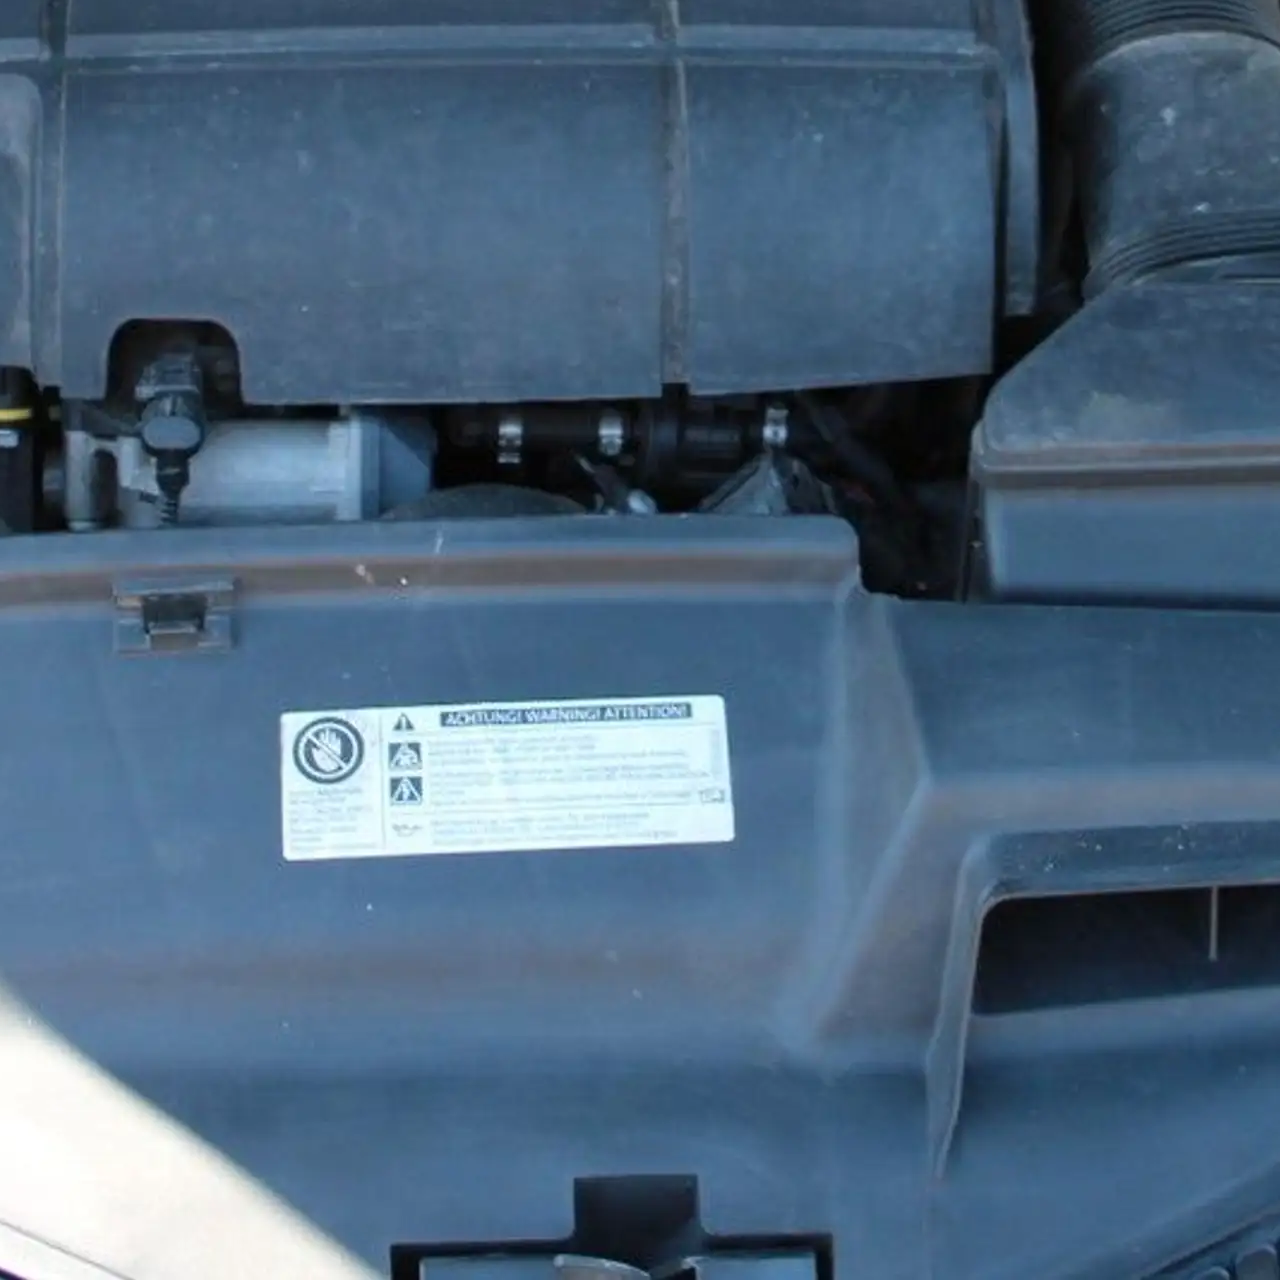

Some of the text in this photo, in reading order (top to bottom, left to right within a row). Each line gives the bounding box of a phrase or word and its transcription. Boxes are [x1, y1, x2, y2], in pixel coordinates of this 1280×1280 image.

[445, 703, 687, 726] ACHTUNG! WARNING! ATTENTION!
